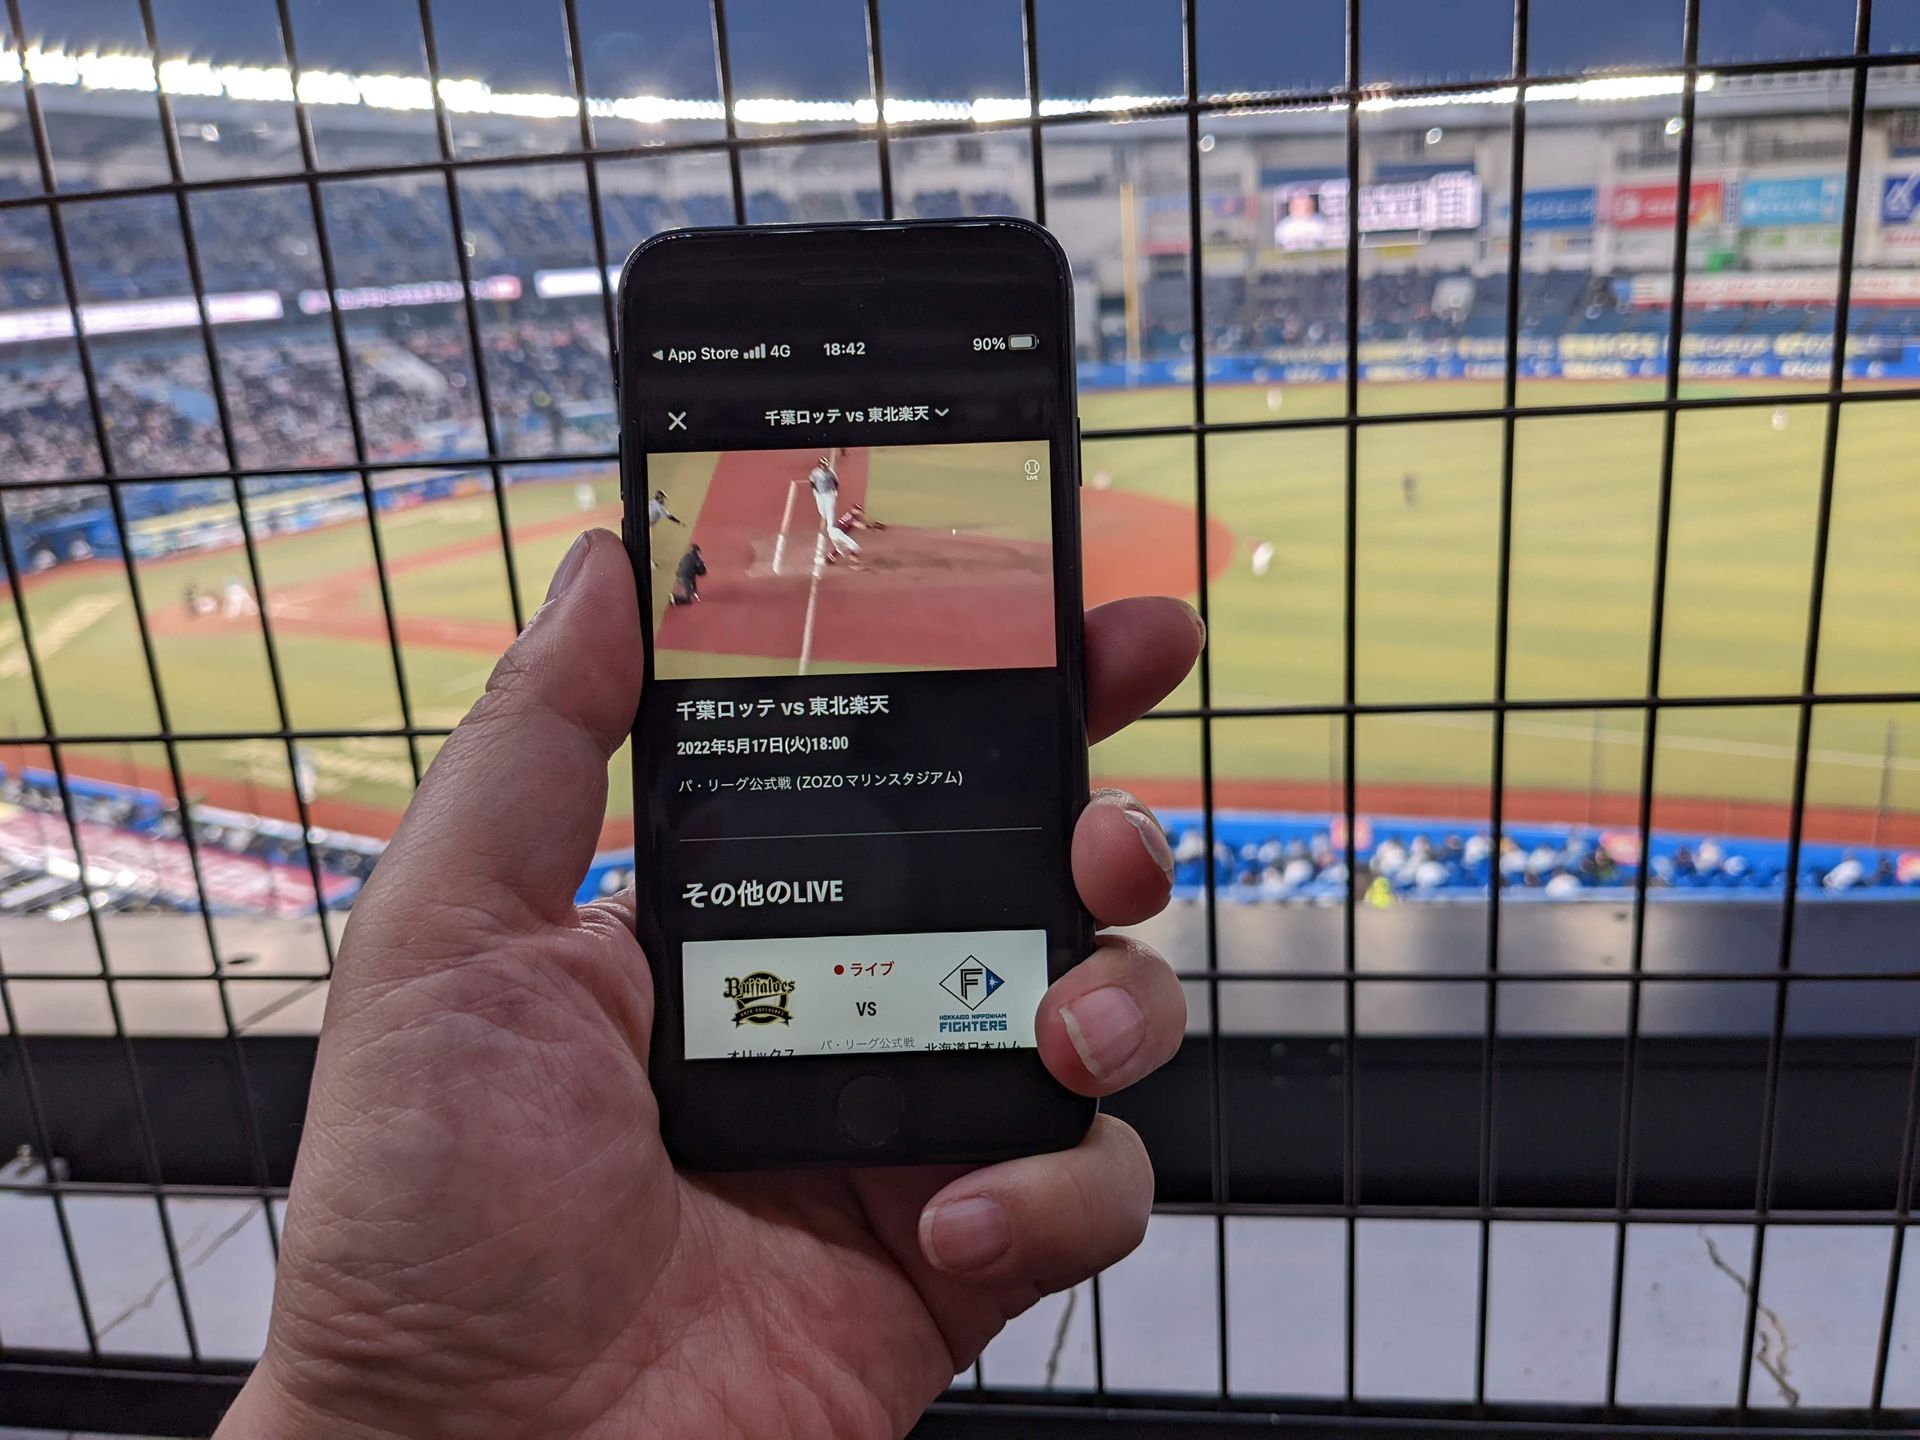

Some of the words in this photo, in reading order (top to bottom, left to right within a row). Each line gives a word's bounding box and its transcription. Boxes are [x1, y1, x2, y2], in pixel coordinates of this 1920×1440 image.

[770, 344, 791, 358] 4G
[823, 342, 866, 356] 18:42
[973, 337, 1005, 351] 90%
[668, 348, 697, 363] App
[701, 346, 739, 360] Store
[765, 408, 841, 425] 千葉ロッテ
[845, 410, 864, 423] vs
[868, 405, 929, 422] 東北楽天
[676, 698, 775, 721] 千葉ロッテ
[781, 701, 804, 716] vs
[809, 694, 889, 716] 東北楽天
[677, 736, 849, 755] 2022年5月17日(火)18:00
[678, 776, 792, 792] パ・リーグ公式戦
[682, 880, 843, 908] その他のLIVE
[850, 961, 895, 977] ライブ
[723, 976, 796, 999] Buffaloes
[939, 1020, 1008, 1033] FIGHTERS
